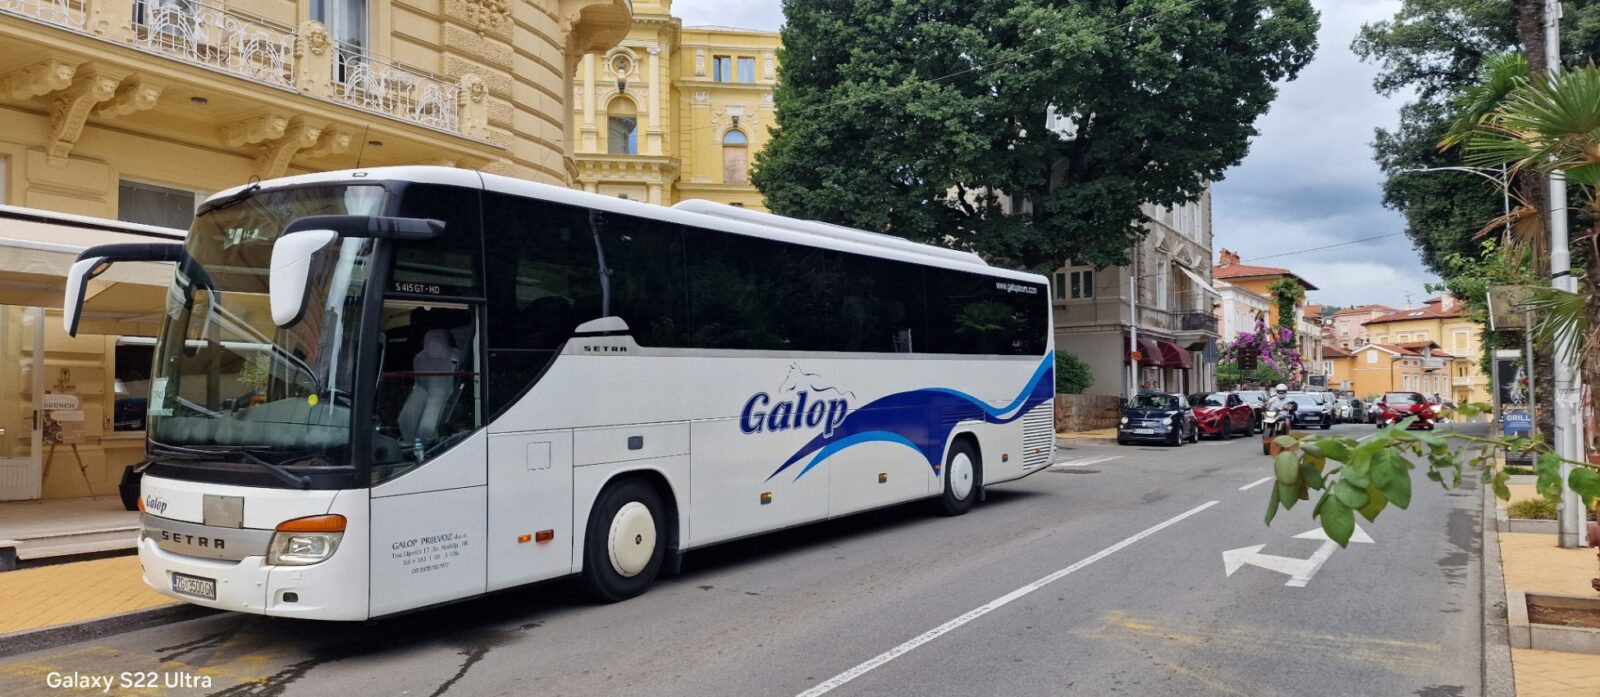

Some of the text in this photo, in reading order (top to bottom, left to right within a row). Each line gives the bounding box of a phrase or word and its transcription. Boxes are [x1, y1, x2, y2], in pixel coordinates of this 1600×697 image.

[395, 282, 401, 292] S
[402, 283, 414, 292] 415
[740, 390, 848, 439] Galop
[1506, 414, 1531, 422] GRILL
[146, 494, 168, 514] Galop
[161, 530, 225, 550] SETRA
[392, 538, 418, 550] GALOP
[421, 532, 453, 545] PRIJEVOZ
[176, 576, 186, 591] ZG
